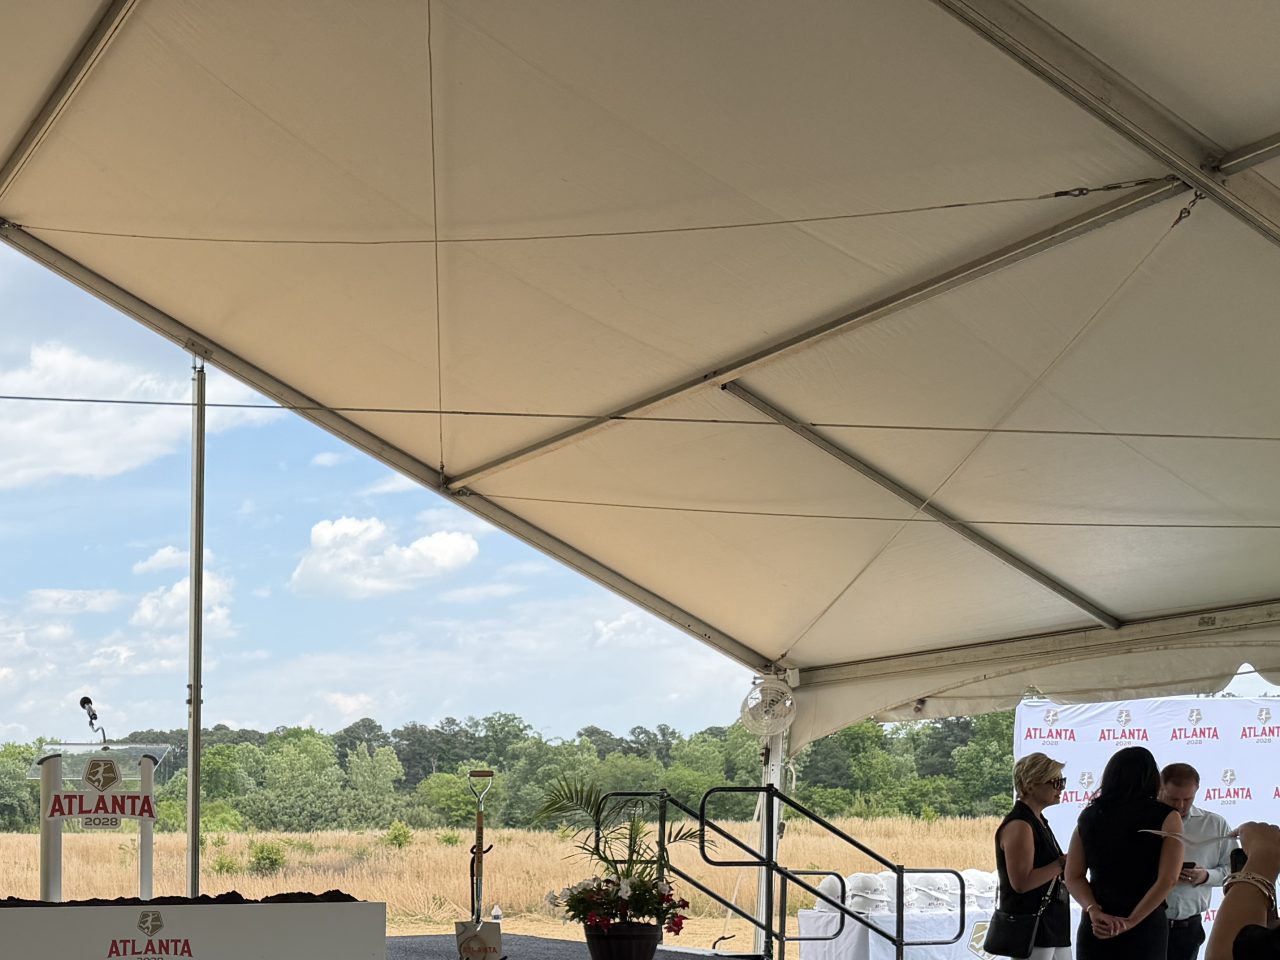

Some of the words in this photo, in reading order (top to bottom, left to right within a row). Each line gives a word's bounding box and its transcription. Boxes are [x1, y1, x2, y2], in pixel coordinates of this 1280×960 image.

[1024, 727, 1076, 741] ATLANTA
[1099, 728, 1149, 742] ATLANTA
[1170, 726, 1219, 740] ATLANTA
[1204, 787, 1252, 801] ATLANTA
[48, 794, 155, 818] ATLANTA
[84, 817, 118, 826] 2028
[108, 939, 193, 958] ATLANTA
